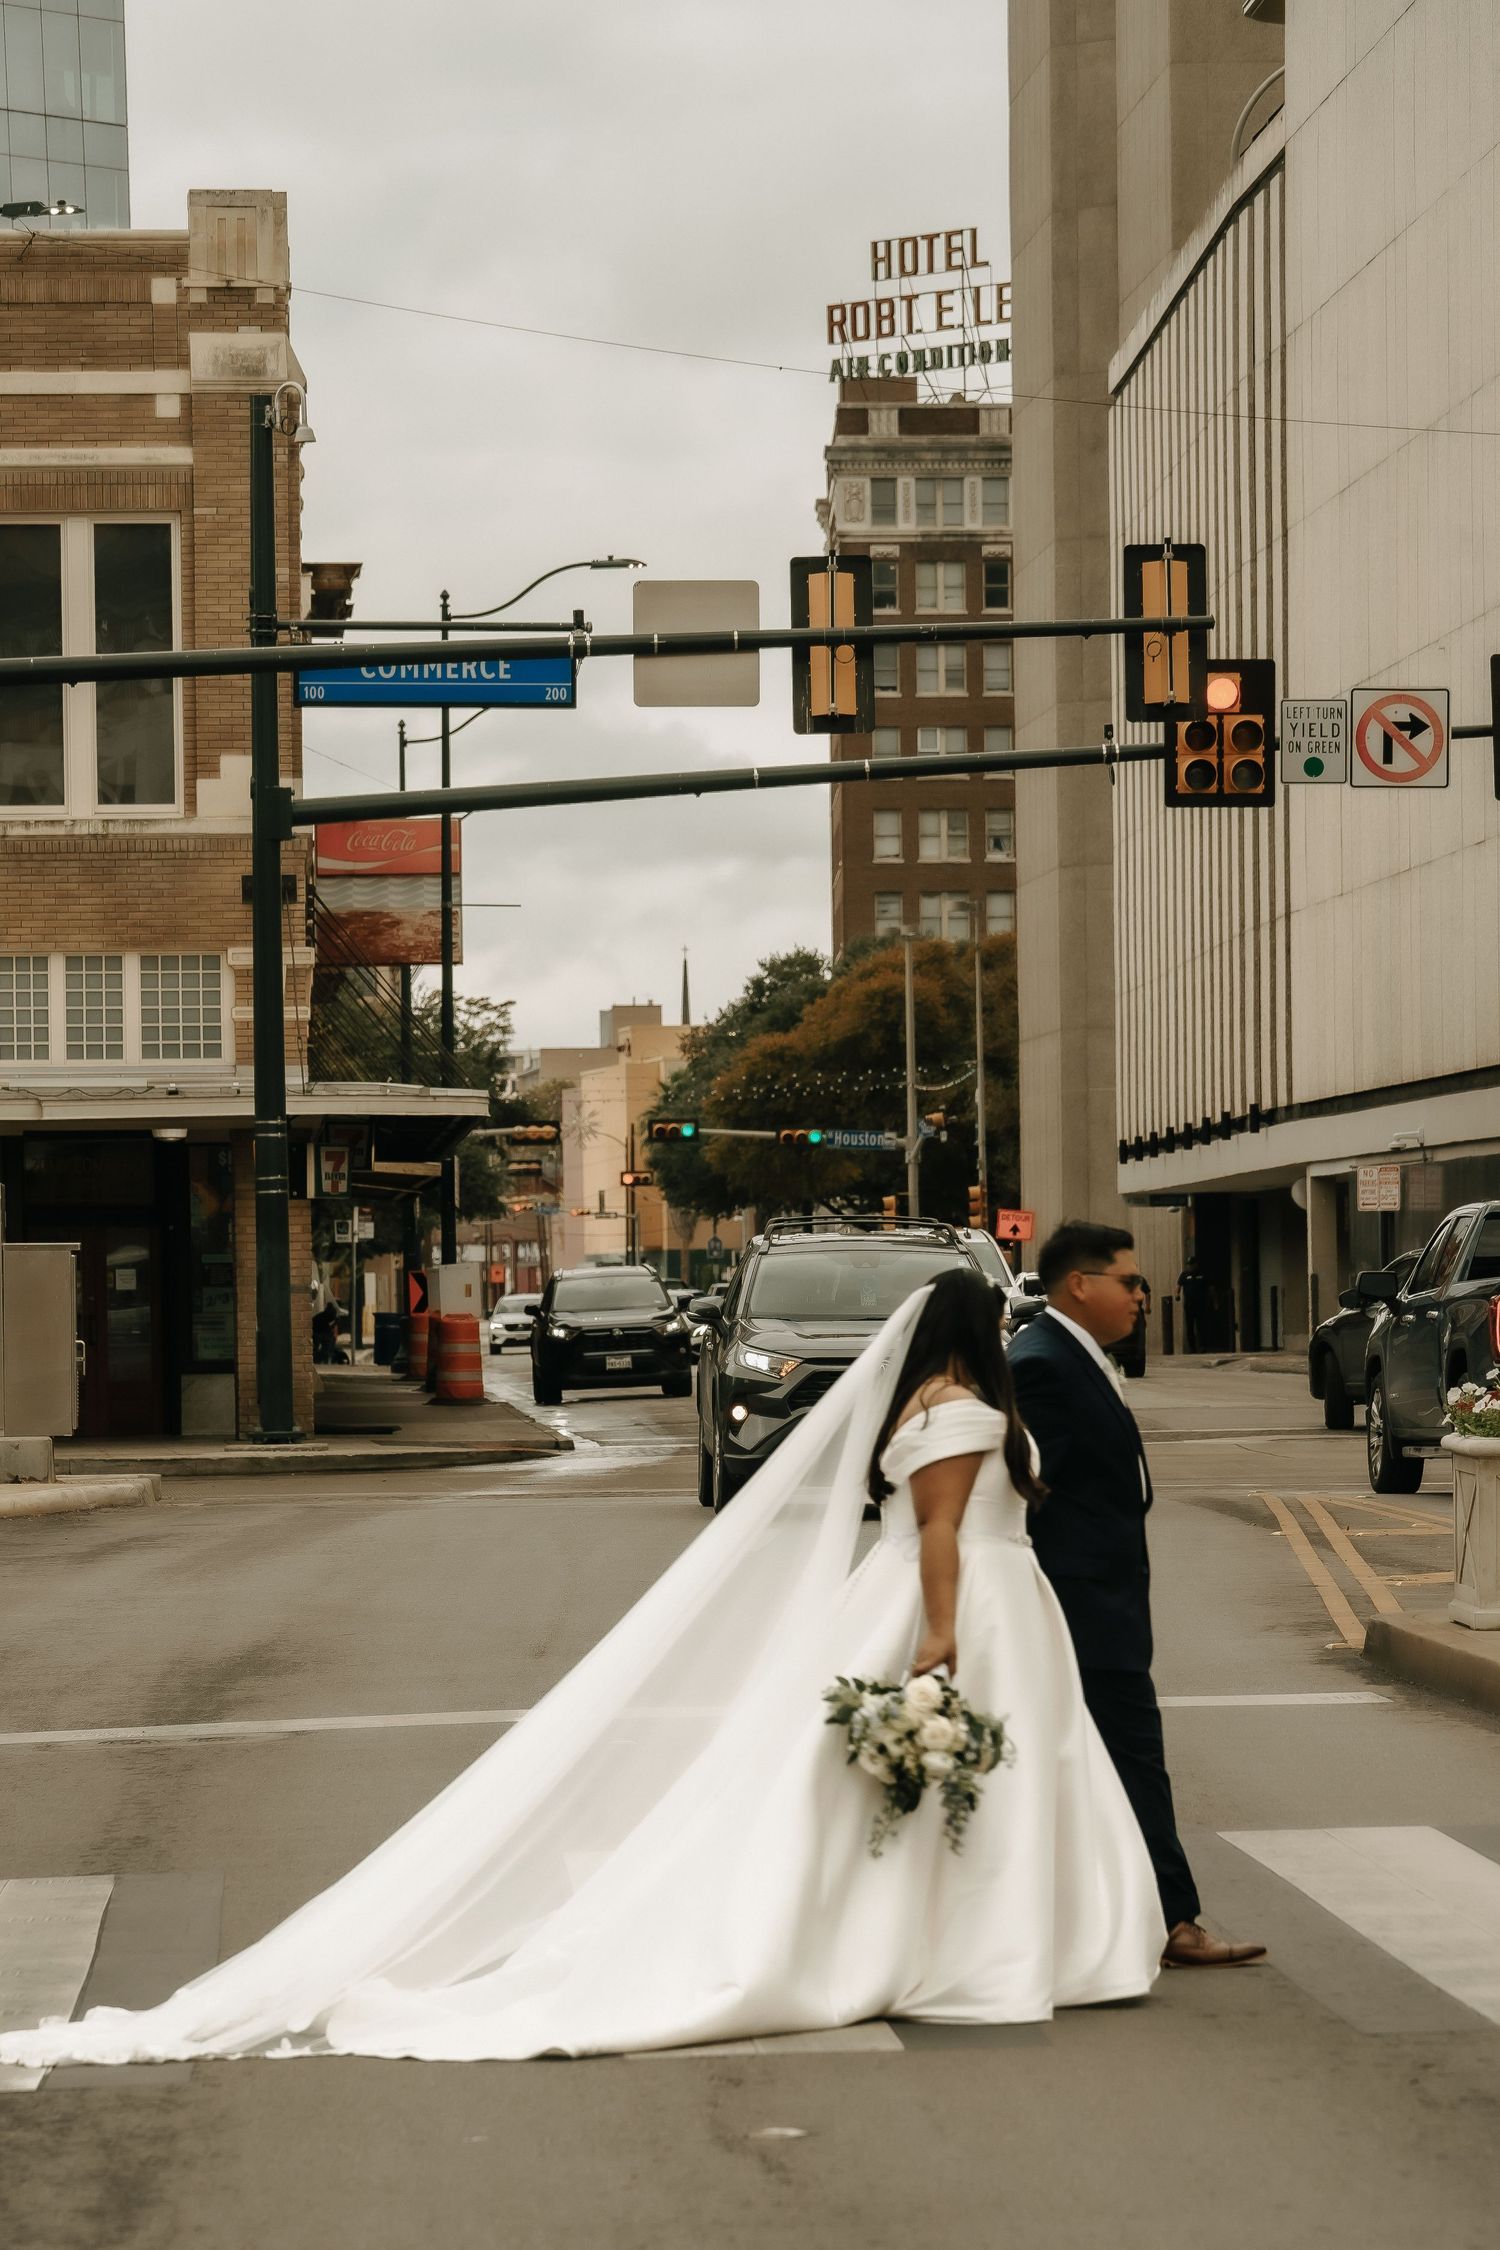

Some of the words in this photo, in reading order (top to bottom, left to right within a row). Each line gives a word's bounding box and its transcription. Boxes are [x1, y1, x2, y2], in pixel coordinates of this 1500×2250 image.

[870, 227, 989, 281] HOTEL
[829, 357, 870, 383] AIR
[303, 686, 325, 700] 100
[545, 687, 567, 701] 200
[1286, 706, 1311, 719] LEFT
[1316, 707, 1343, 720] TURN
[1289, 722, 1341, 738] YIELD
[1288, 741, 1302, 754] ON
[1307, 741, 1341, 754] GREEN
[834, 1130, 884, 1146] Houston
[1001, 1213, 1031, 1222] DETOUR
